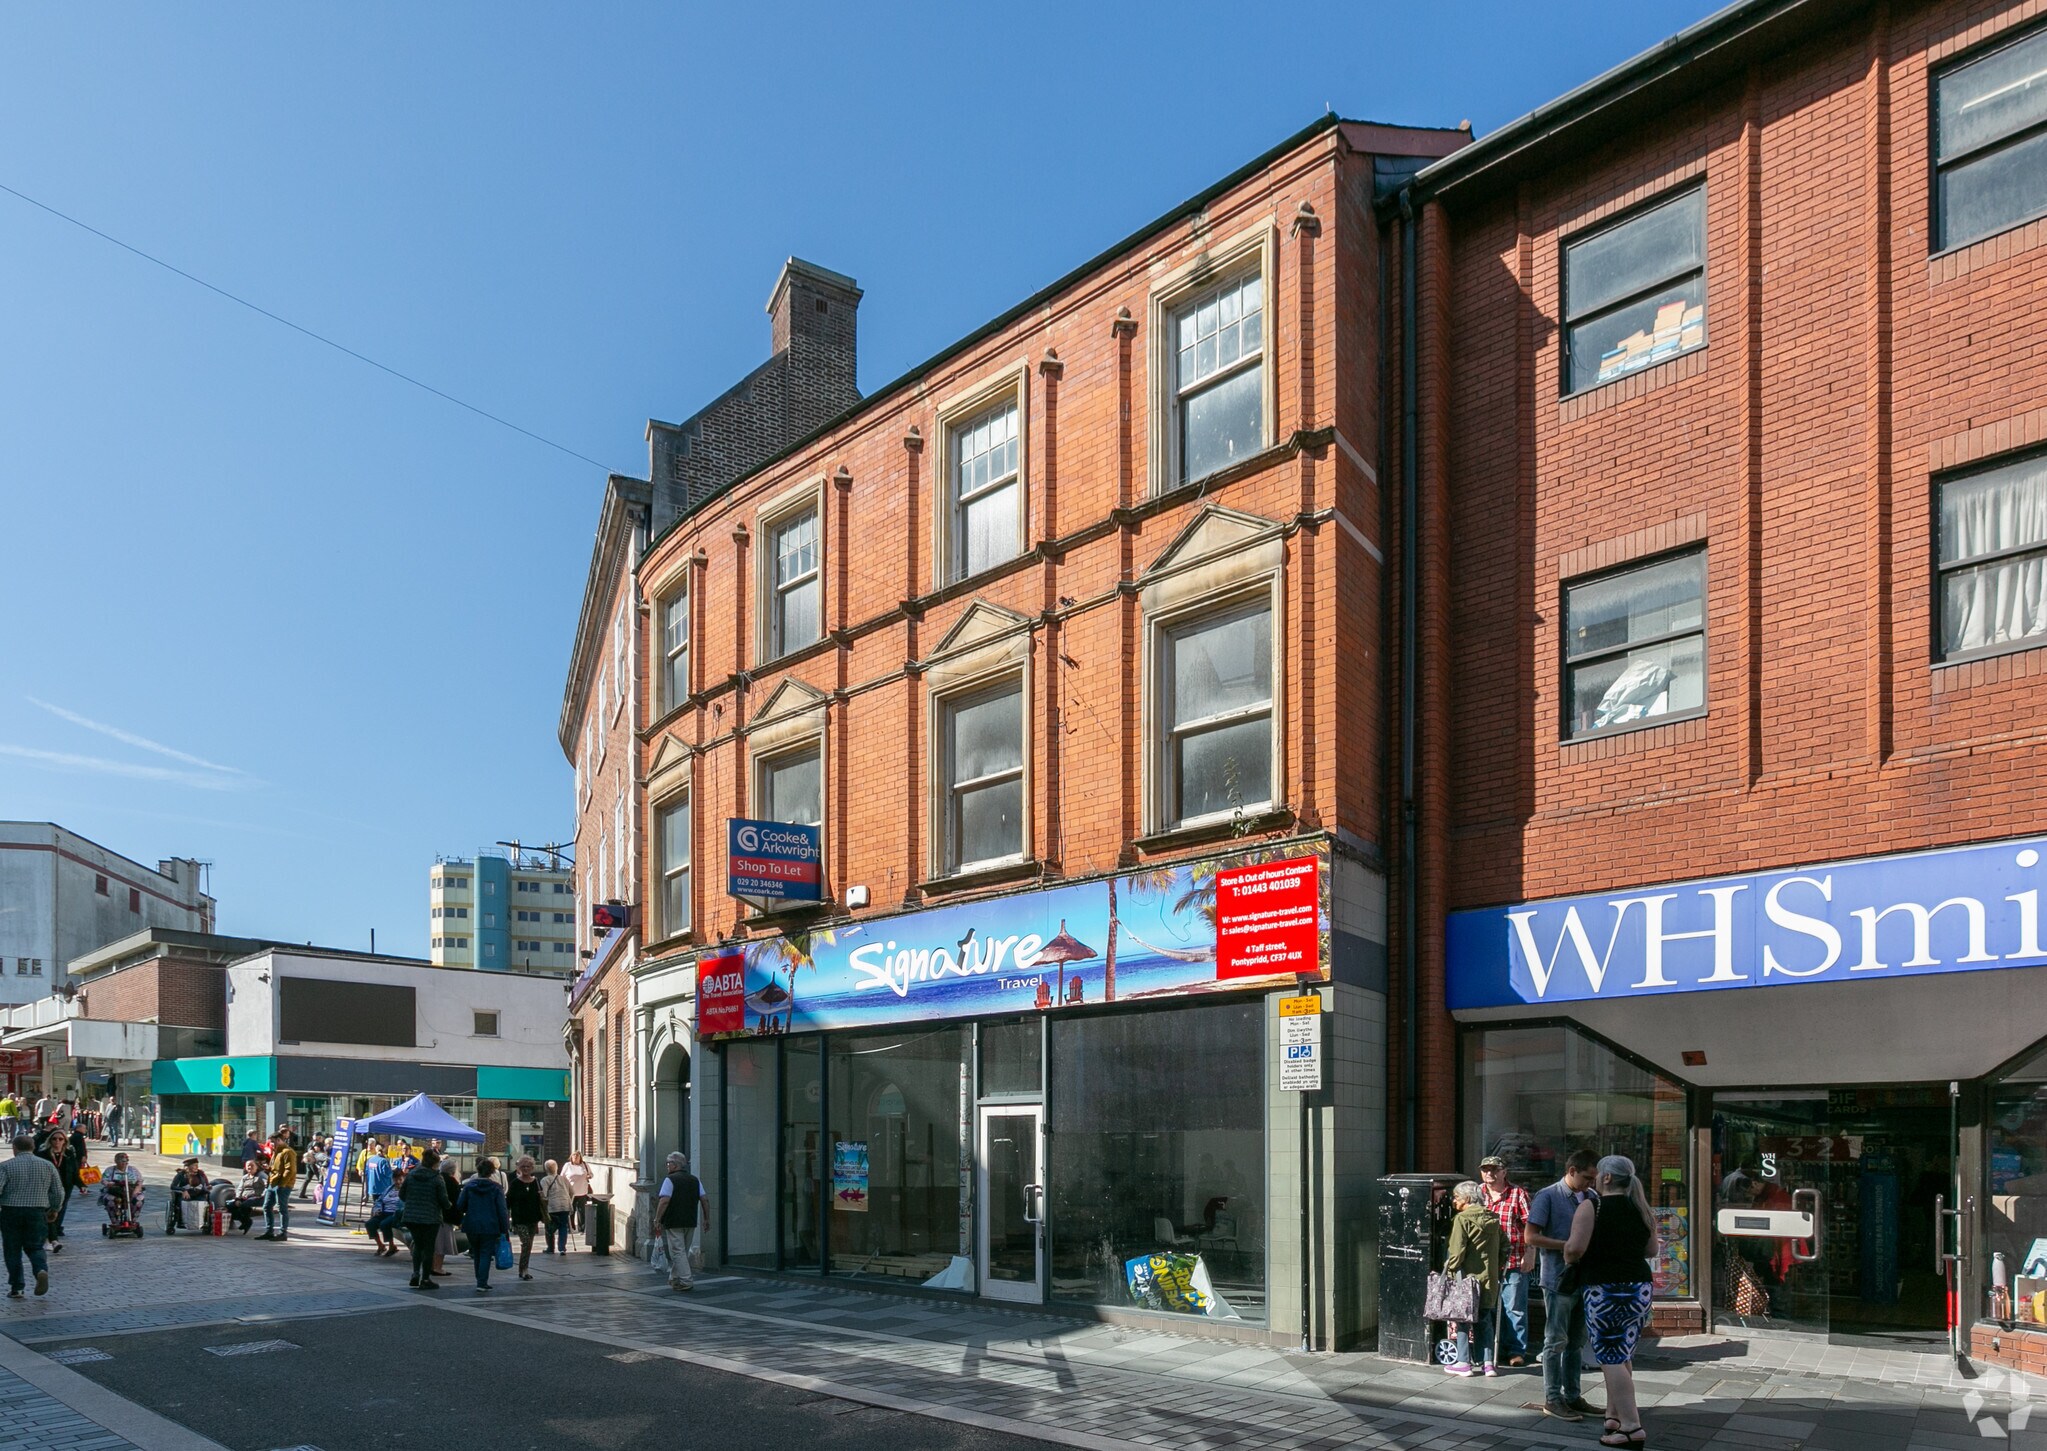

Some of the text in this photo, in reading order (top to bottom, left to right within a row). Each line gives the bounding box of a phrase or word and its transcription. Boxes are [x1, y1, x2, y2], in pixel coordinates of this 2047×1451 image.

[761, 829, 809, 845] Cooke&
[761, 842, 820, 859] Arkwright
[737, 860, 802, 876] Shop To Let
[1221, 864, 1313, 887] Store & Out of hours Contact:
[737, 878, 749, 886] 029
[760, 879, 783, 889] 346346
[737, 887, 784, 896] www.coark.com
[1232, 877, 1301, 897] T: 01443 401039
[1221, 905, 1312, 924] W: www.signature-travel.com
[1221, 917, 1313, 936] E: sales@signature-travel.com
[1245, 942, 1287, 953] 4 Taff street,
[849, 928, 1044, 997] Signature
[1231, 951, 1302, 967] Pontypridd, CF37 4UX
[714, 972, 743, 992] ABTA
[997, 974, 1043, 990] Travel
[1828, 1092, 1857, 1104] GIF
[1827, 1105, 1867, 1114] CARDS
[1786, 1138, 1803, 1157] 3
[1817, 1137, 1835, 1157] 2
[1761, 1158, 1777, 1177] S
